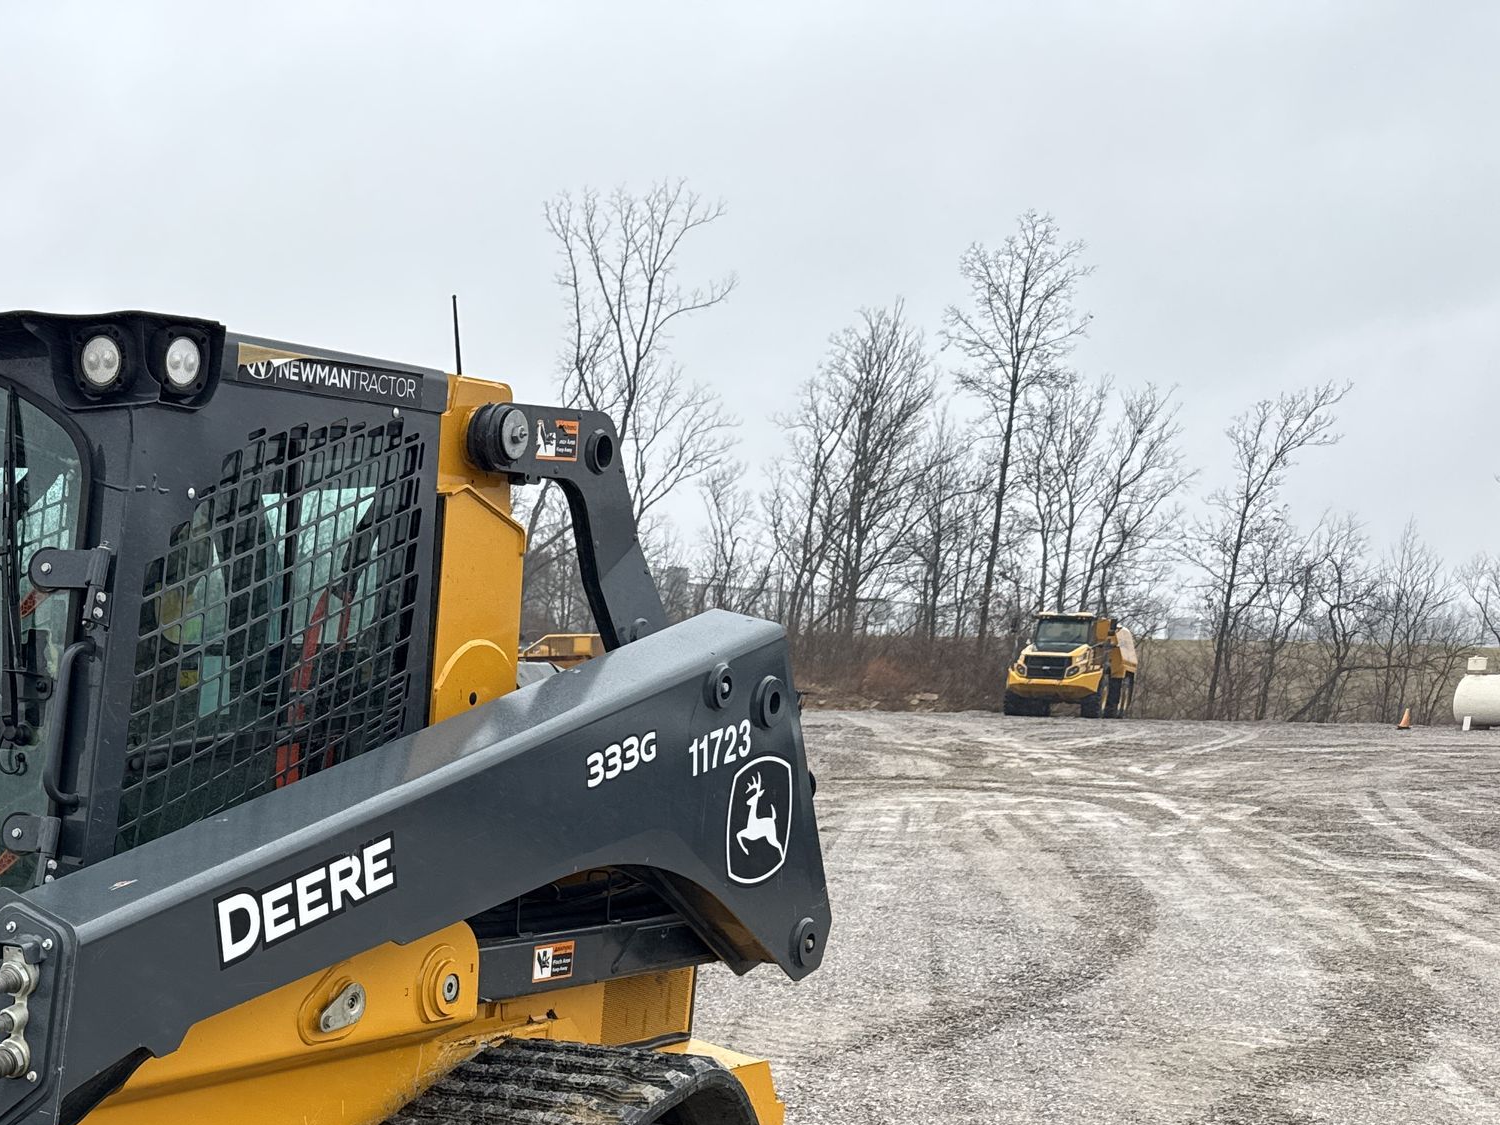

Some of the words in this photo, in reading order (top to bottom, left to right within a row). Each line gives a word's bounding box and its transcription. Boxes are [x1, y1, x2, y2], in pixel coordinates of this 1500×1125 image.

[278, 359, 416, 399] NEWMANTRACTOR
[586, 731, 657, 788] 333G
[688, 718, 751, 777] 11723
[217, 837, 394, 963] DEERE
